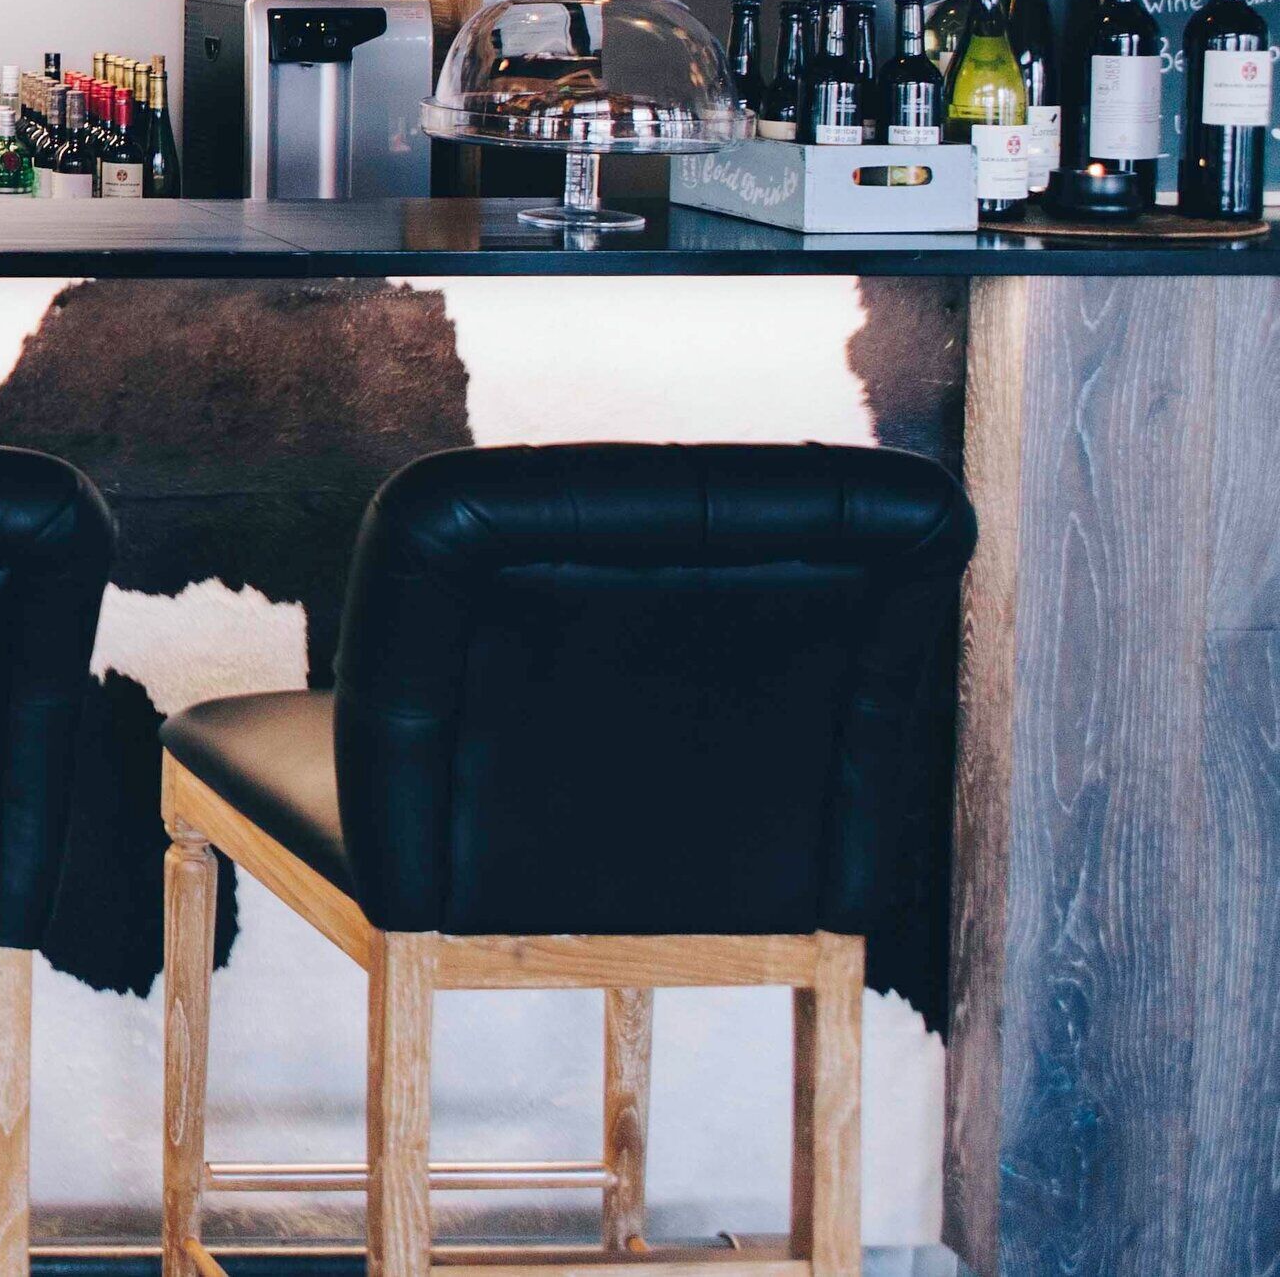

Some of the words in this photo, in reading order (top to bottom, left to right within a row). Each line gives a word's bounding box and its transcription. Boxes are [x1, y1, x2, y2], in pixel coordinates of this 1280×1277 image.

[893, 128, 911, 136] New
[702, 154, 740, 191] Cold
[741, 169, 800, 208] Drinks
